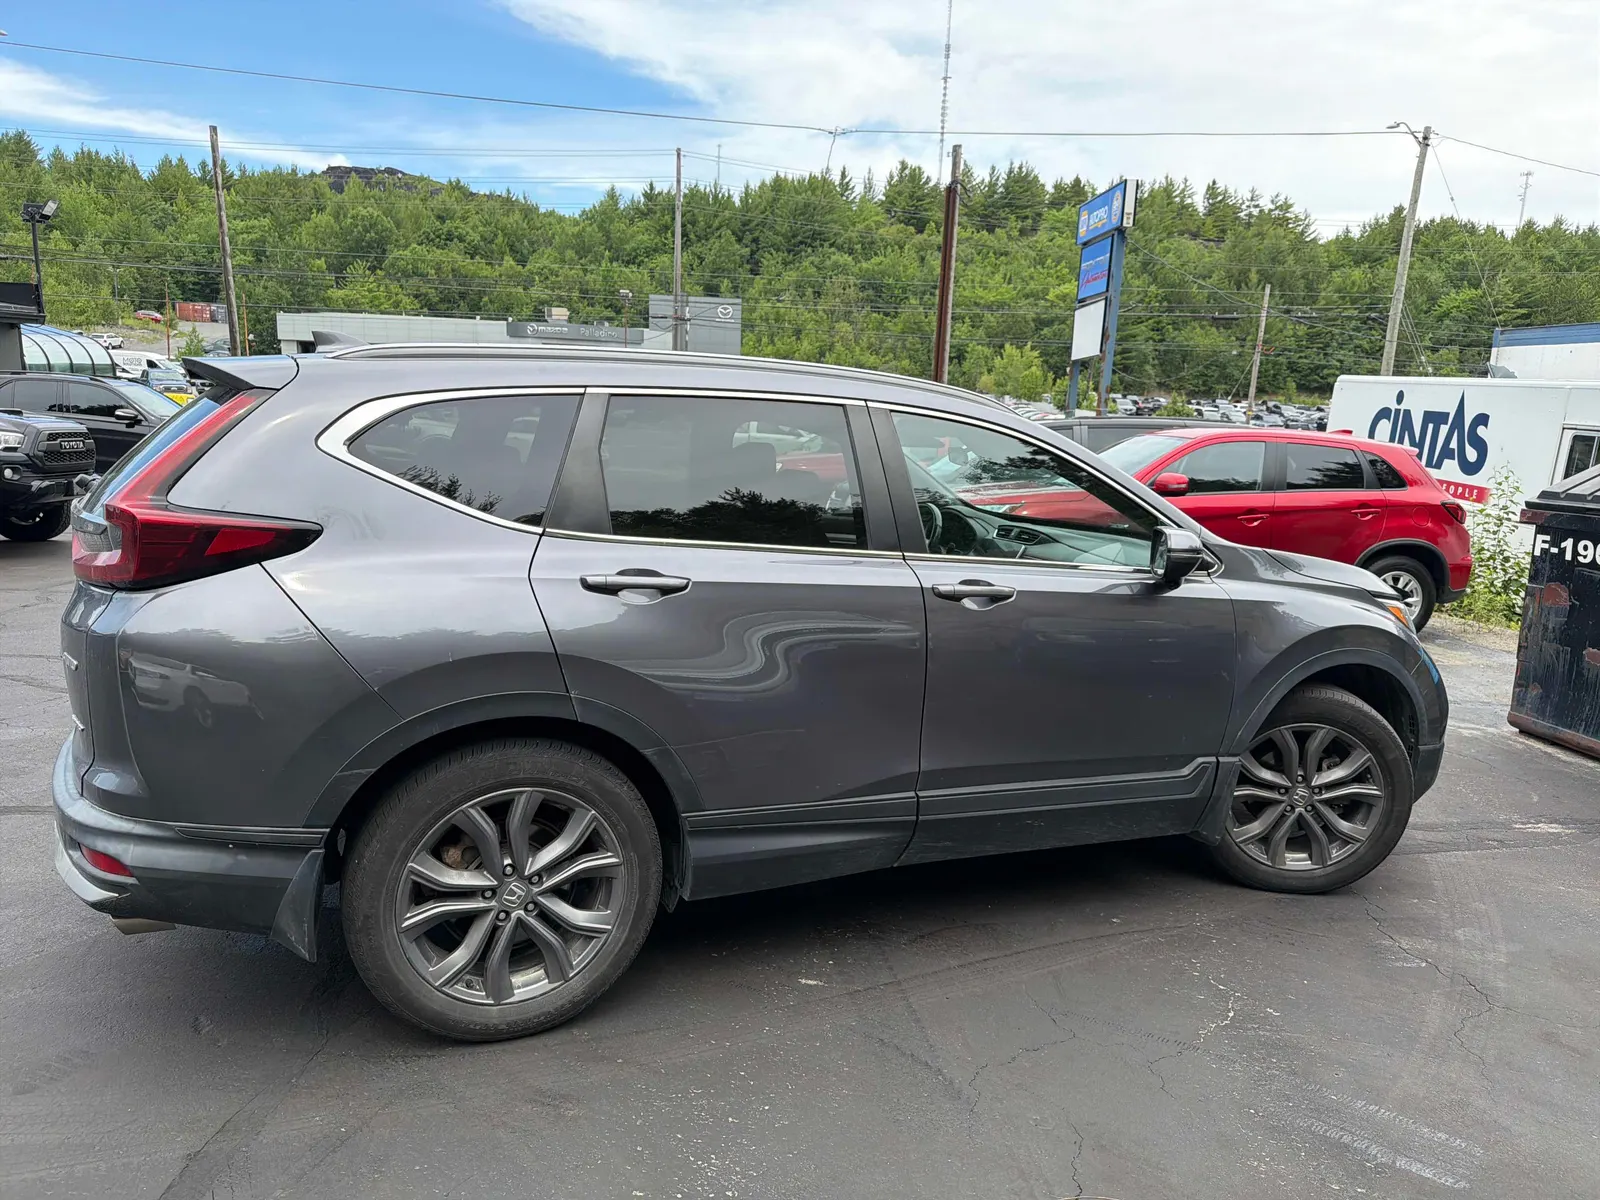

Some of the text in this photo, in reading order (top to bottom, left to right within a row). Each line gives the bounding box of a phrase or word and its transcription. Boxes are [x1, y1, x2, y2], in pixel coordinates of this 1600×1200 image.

[61, 441, 84, 449] TOYOTA
[1442, 483, 1478, 499] EOPLE
[1533, 534, 1600, 566] F-19
